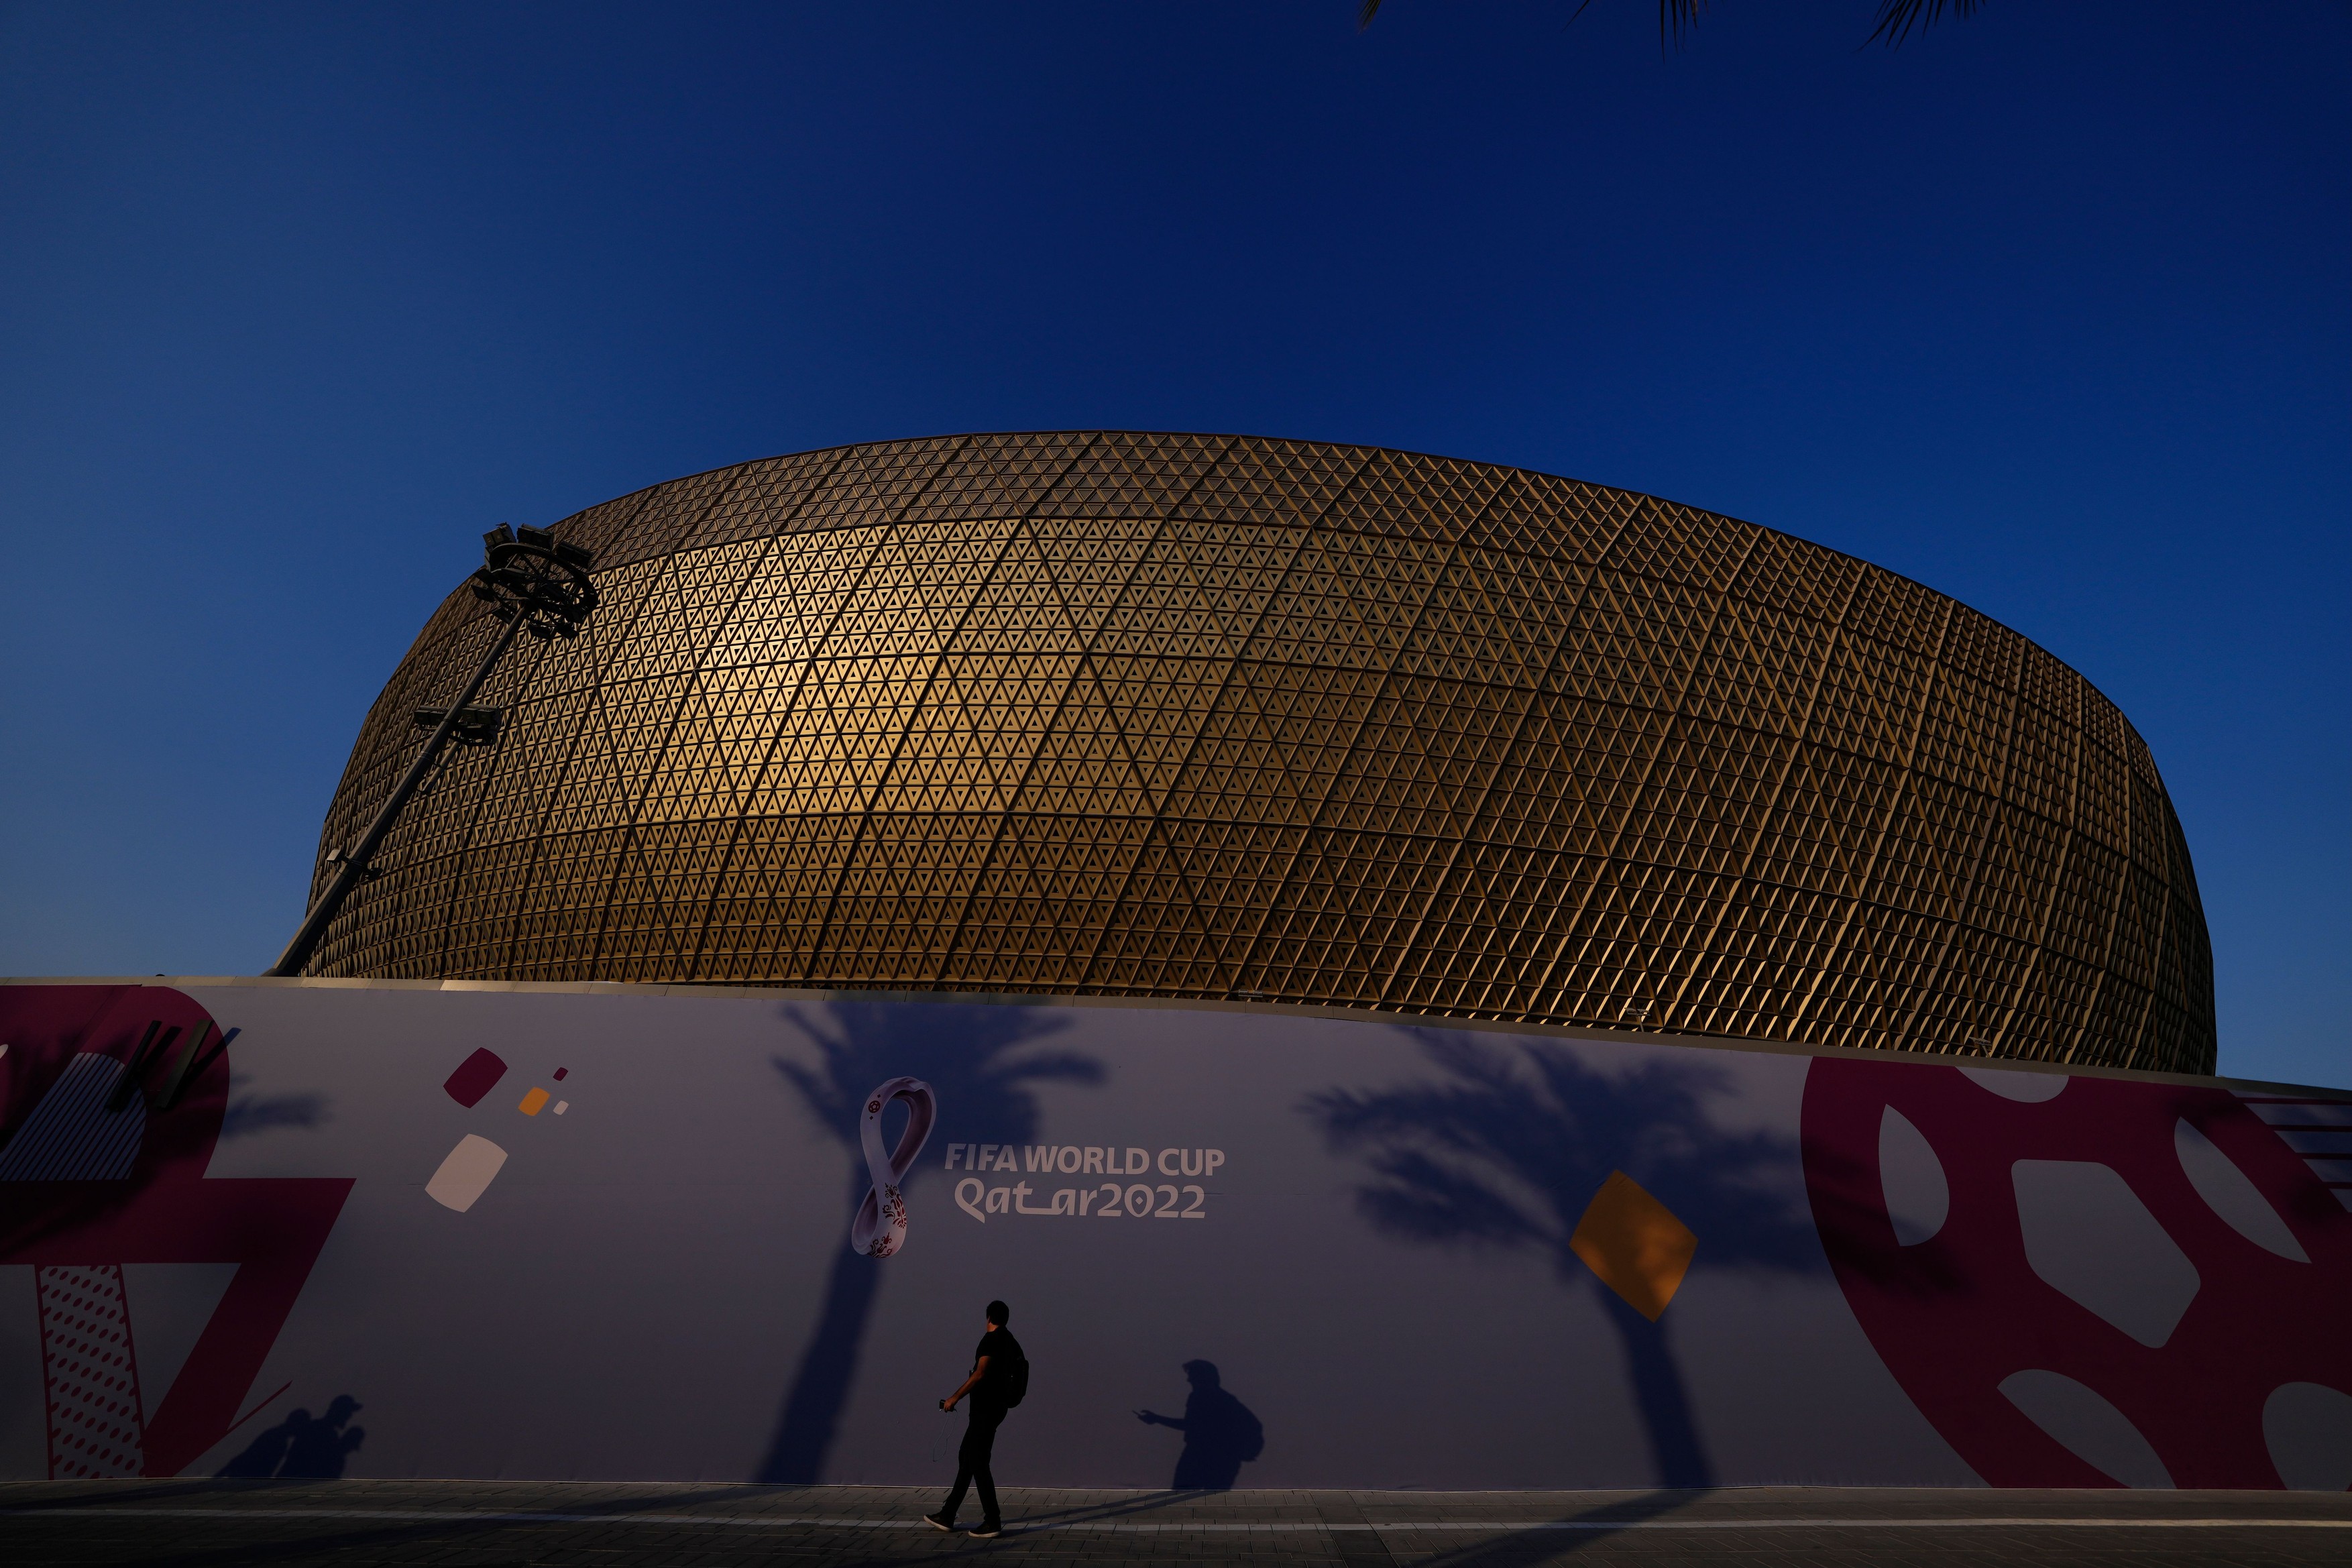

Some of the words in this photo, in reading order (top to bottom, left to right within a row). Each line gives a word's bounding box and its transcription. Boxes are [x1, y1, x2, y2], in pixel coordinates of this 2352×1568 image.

[944, 1143, 1018, 1172] FIFA
[1024, 1145, 1150, 1175] WORLD
[1157, 1147, 1225, 1176] CUP
